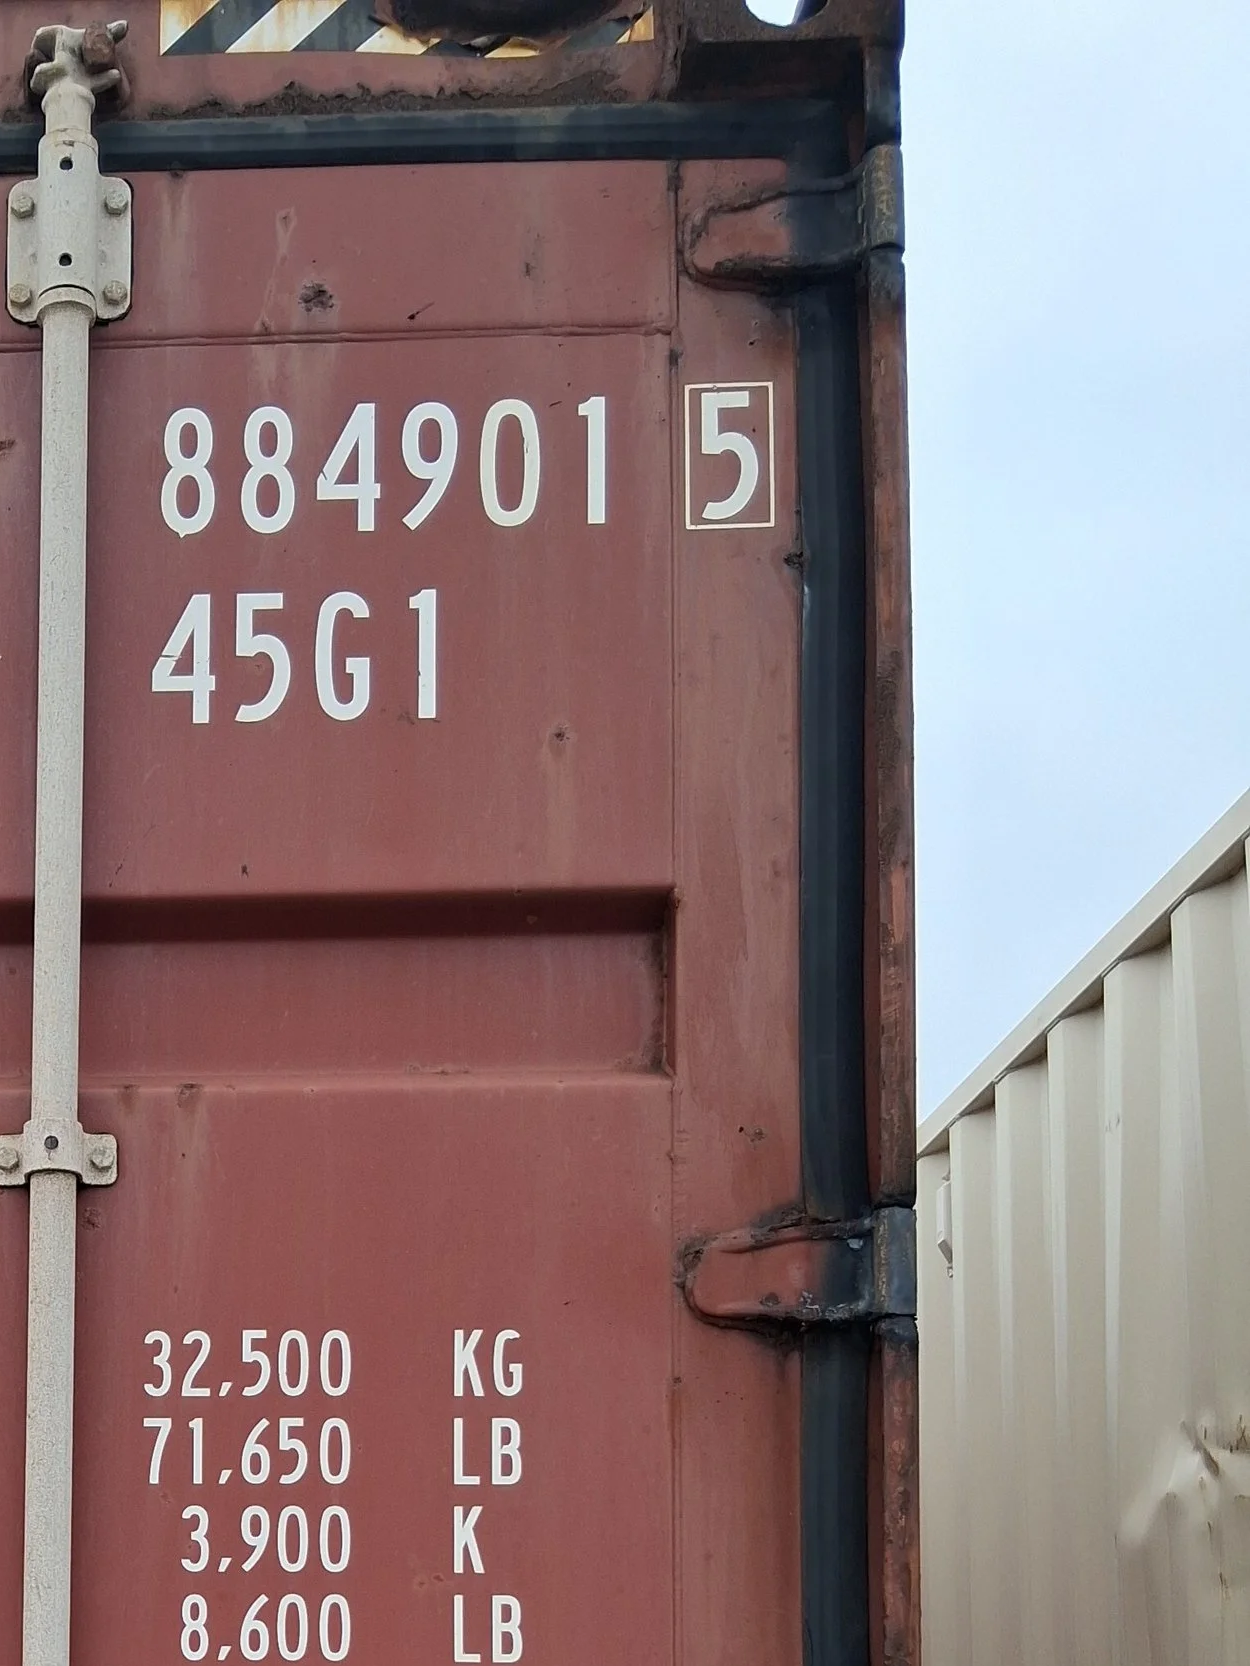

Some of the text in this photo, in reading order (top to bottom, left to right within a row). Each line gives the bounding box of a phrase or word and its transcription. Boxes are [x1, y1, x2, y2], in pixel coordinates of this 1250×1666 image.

[161, 396, 606, 540] 884901
[701, 391, 759, 520] 5
[152, 589, 437, 724] 45G1
[144, 1329, 523, 1397] 32,500 KG
[143, 1418, 522, 1486] 71,650 LB
[181, 1505, 351, 1573] 3,900
[181, 1594, 523, 1664] 8,600 LB
